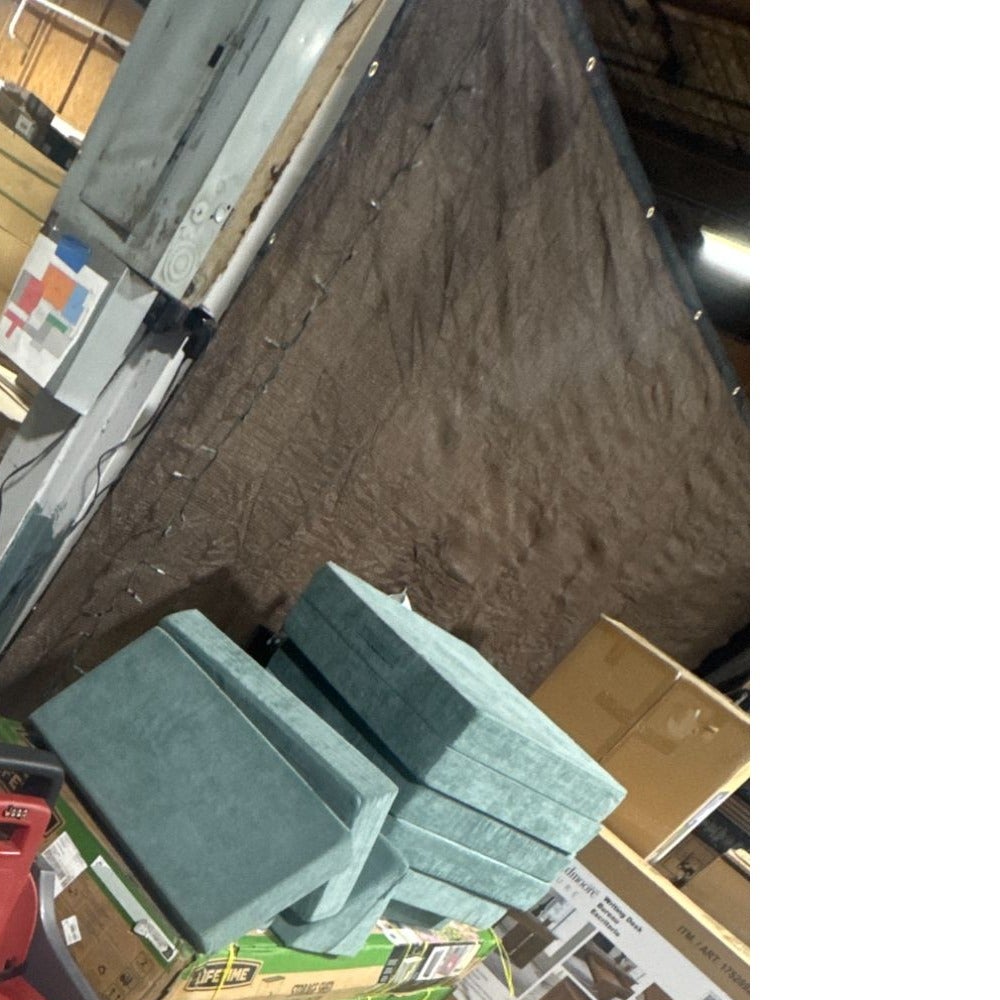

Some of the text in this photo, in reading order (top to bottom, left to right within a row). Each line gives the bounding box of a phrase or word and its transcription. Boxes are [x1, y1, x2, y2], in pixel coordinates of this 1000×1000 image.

[602, 895, 643, 934] Writing Desk
[194, 967, 251, 988] LIFEIME
